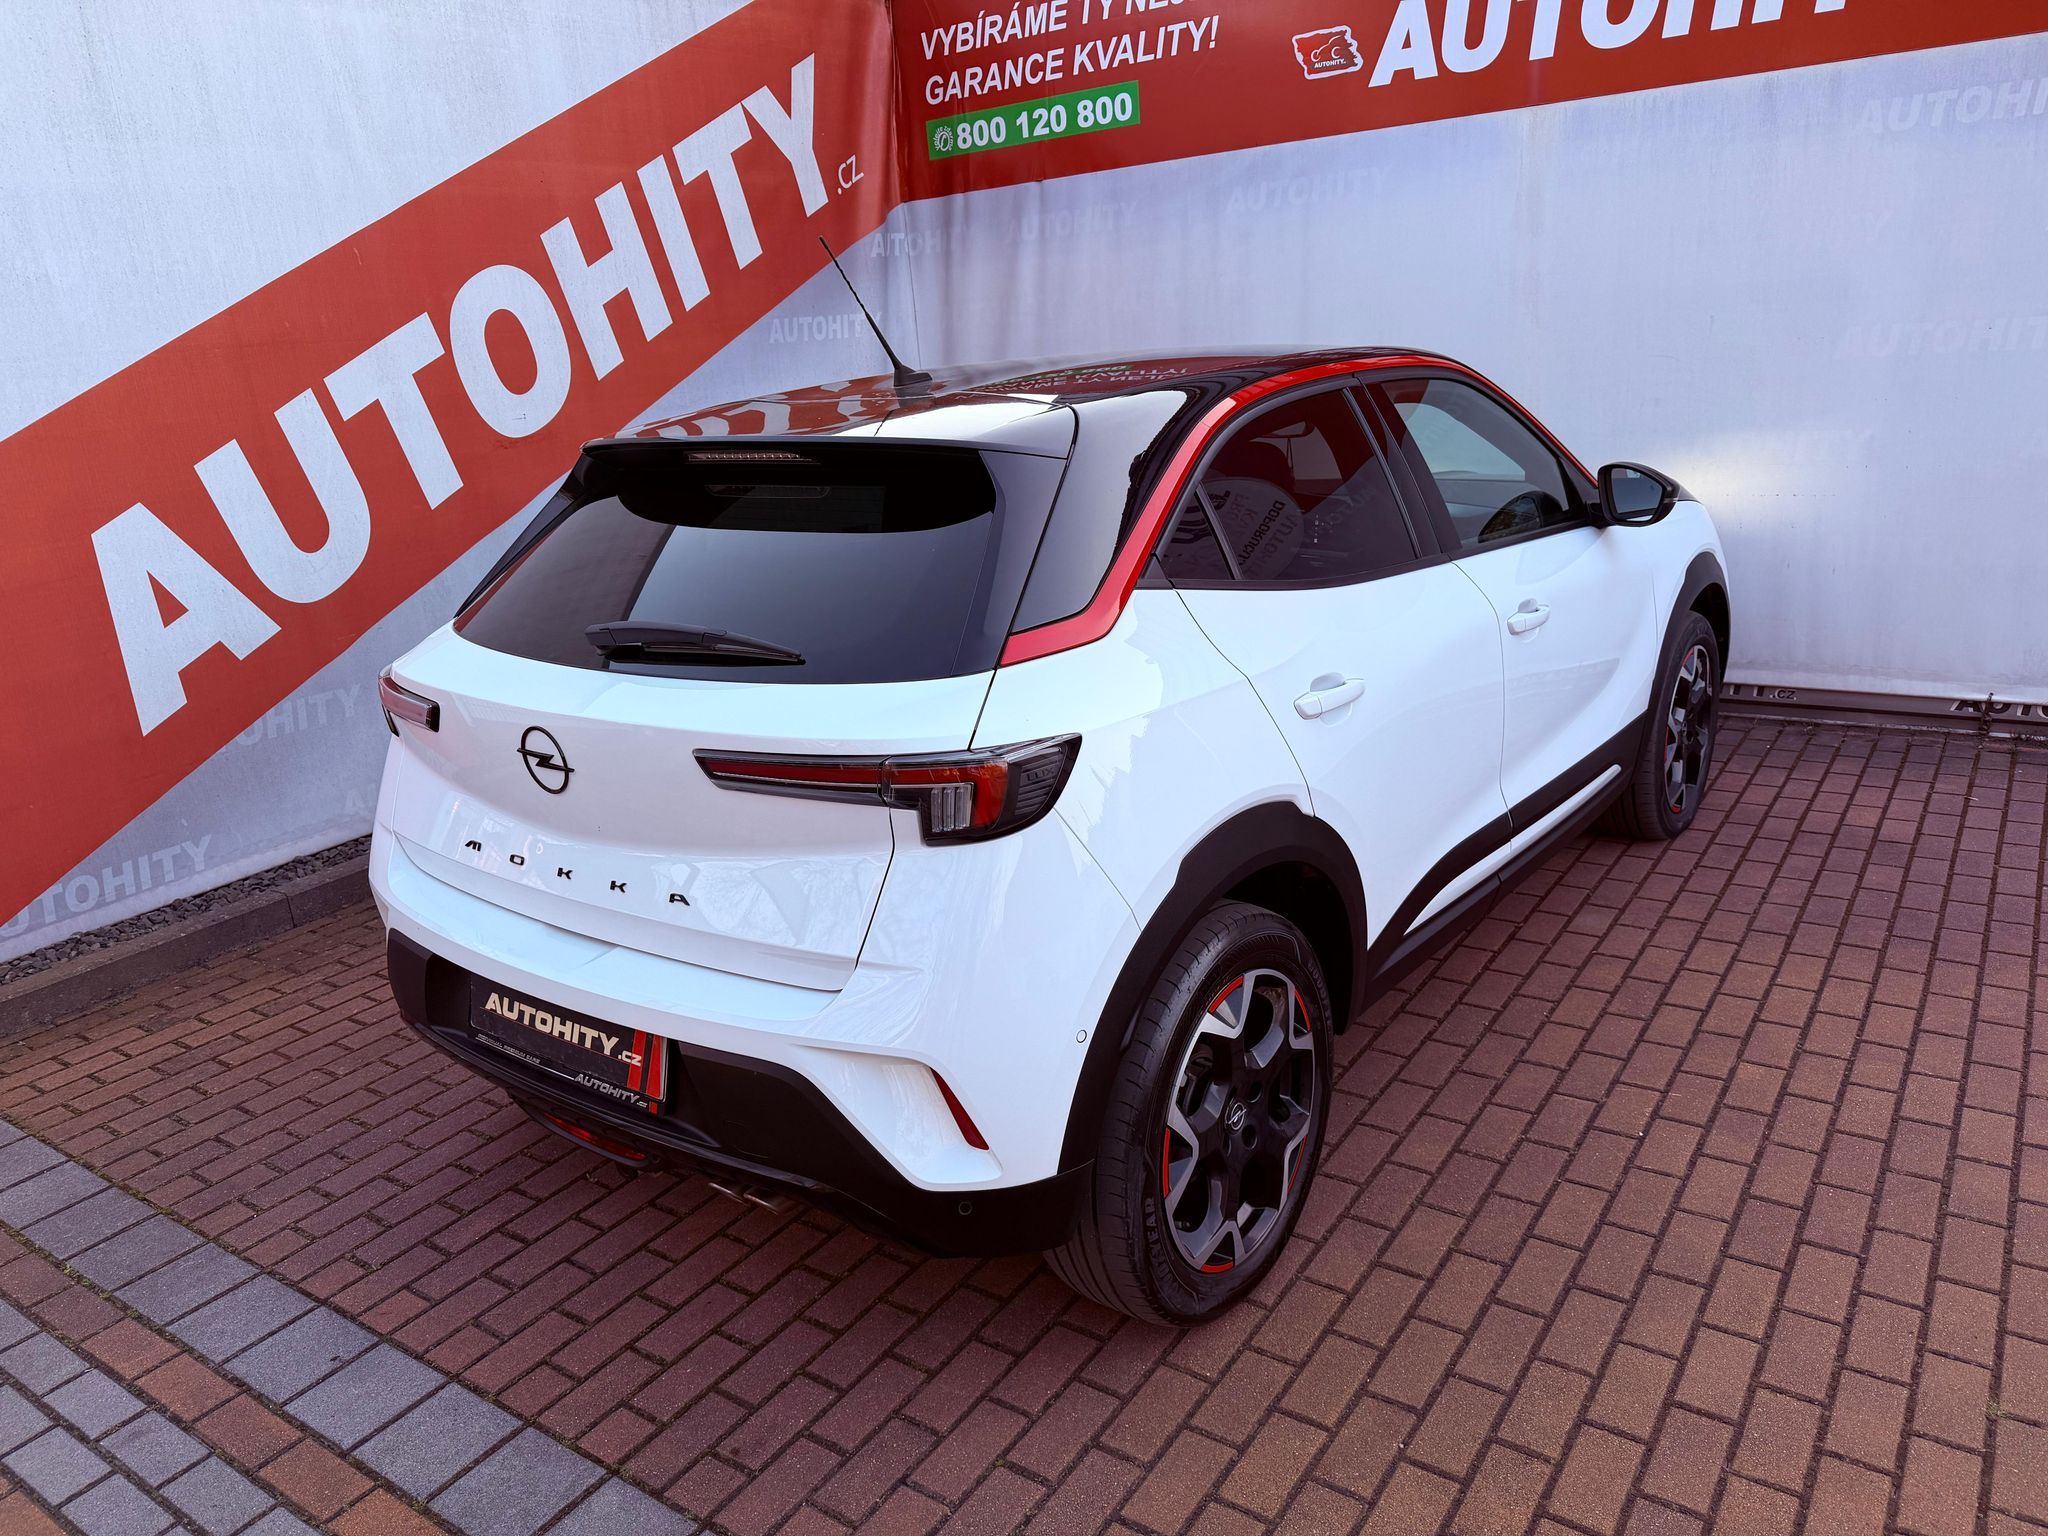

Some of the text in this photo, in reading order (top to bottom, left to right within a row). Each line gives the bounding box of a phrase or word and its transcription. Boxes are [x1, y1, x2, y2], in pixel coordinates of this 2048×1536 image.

[921, 0, 1069, 61] VYBÍRÁME
[925, 15, 1220, 105] GARANCE KVALITY!
[956, 92, 1133, 150] 800 120 800
[465, 839, 690, 906] MOKKA
